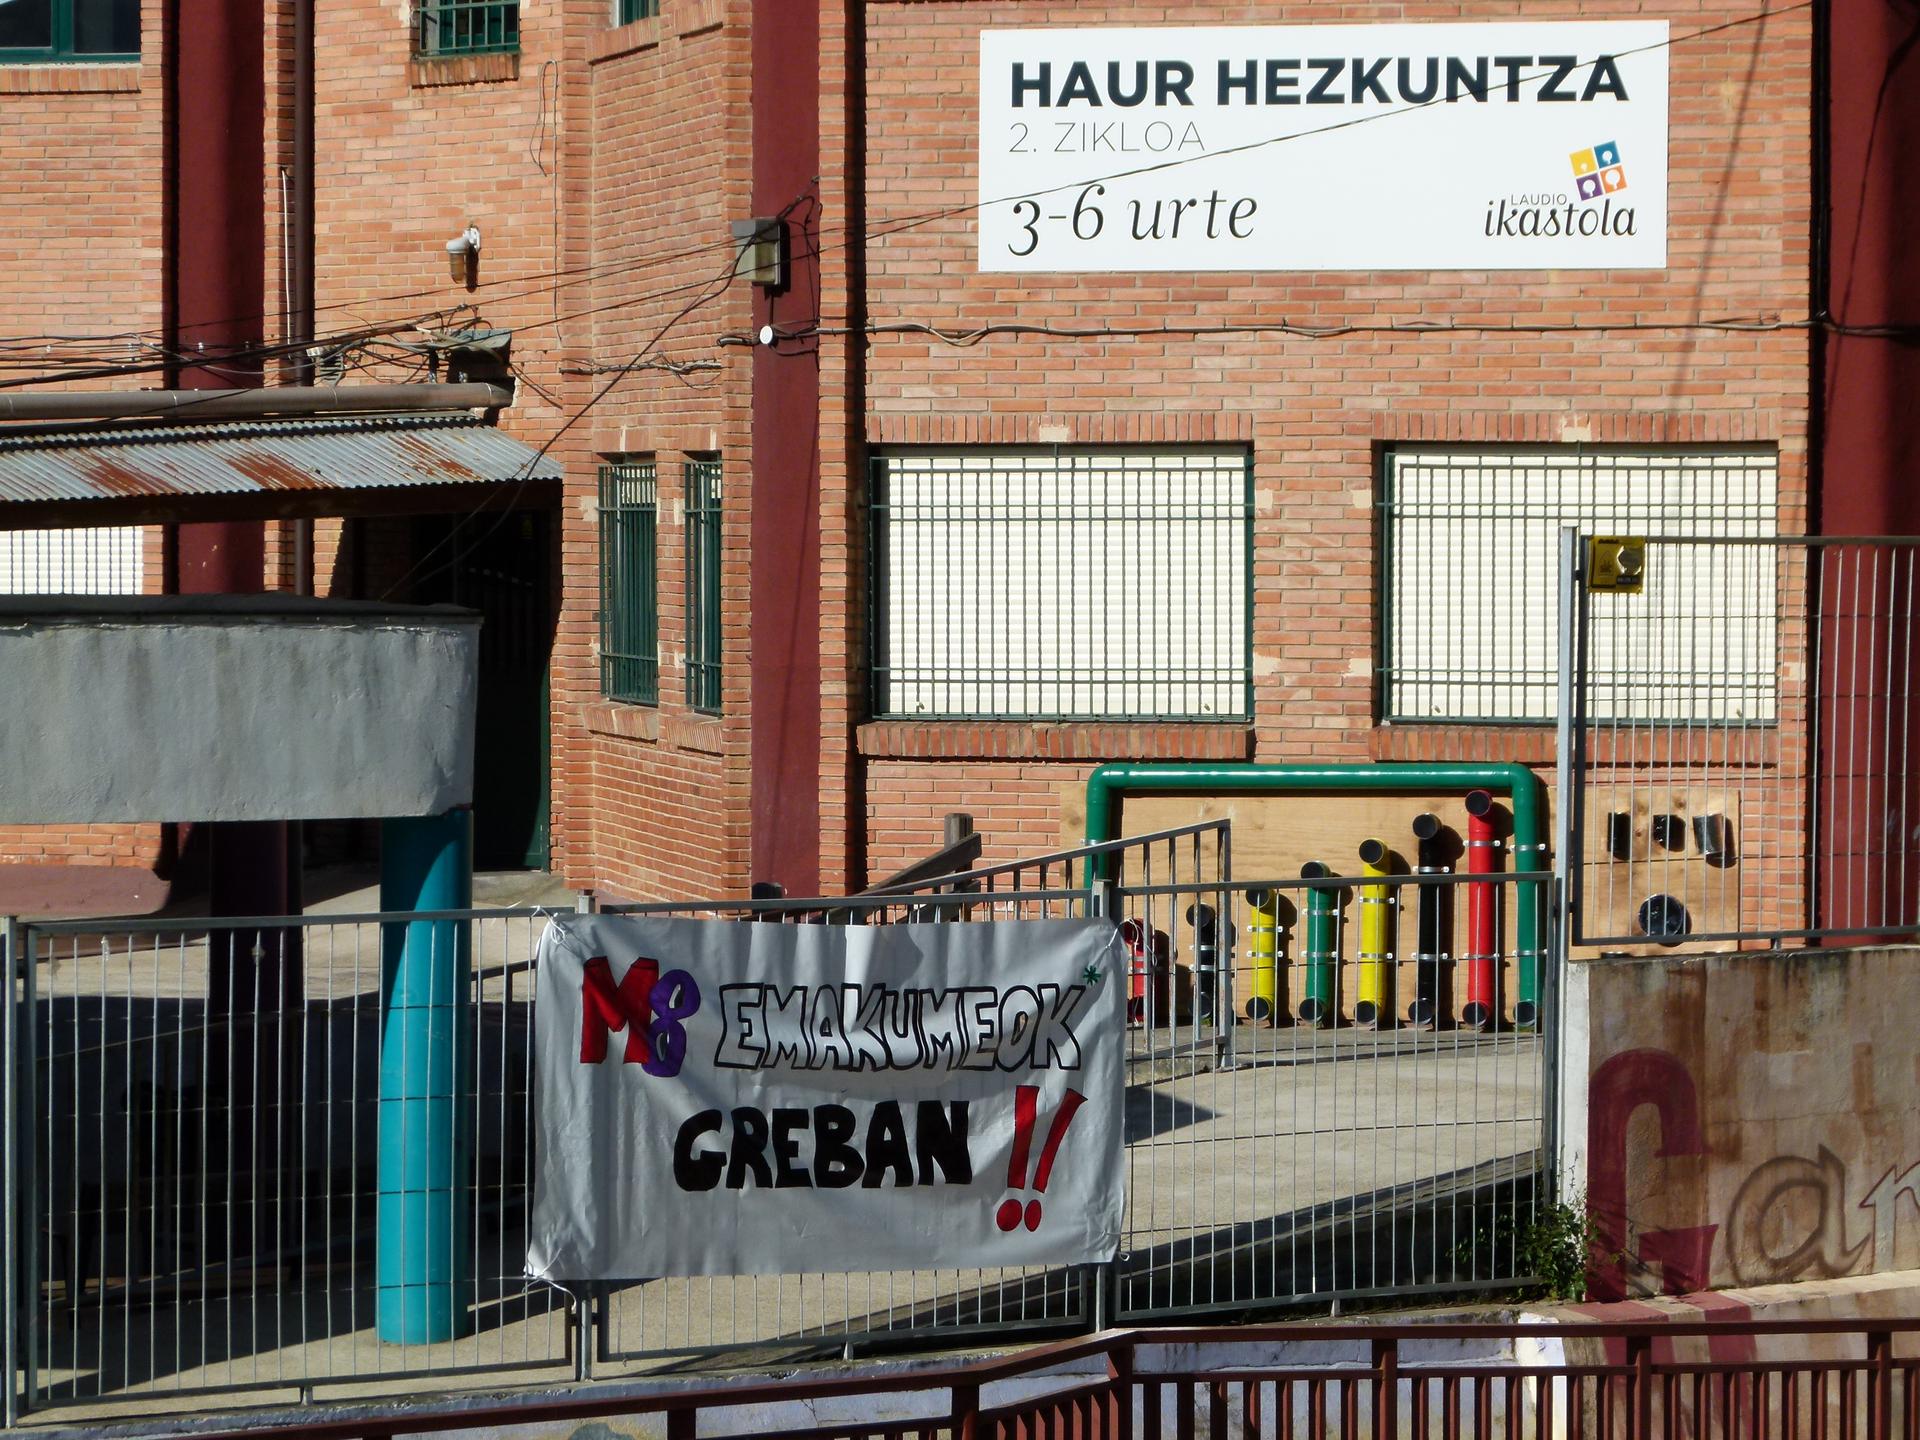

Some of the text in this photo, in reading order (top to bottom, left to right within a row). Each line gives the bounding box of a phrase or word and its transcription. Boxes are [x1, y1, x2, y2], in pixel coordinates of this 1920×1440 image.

[1011, 54, 1630, 108] HAUR HEZKUNTZA
[1008, 120, 1206, 153] 2. ZIKLOA
[1007, 184, 1258, 257] 3-6 urte
[1484, 198, 1638, 237] ikastola
[1510, 193, 1568, 206] LAUDIO
[713, 982, 1087, 1072] EMAKUMEOK
